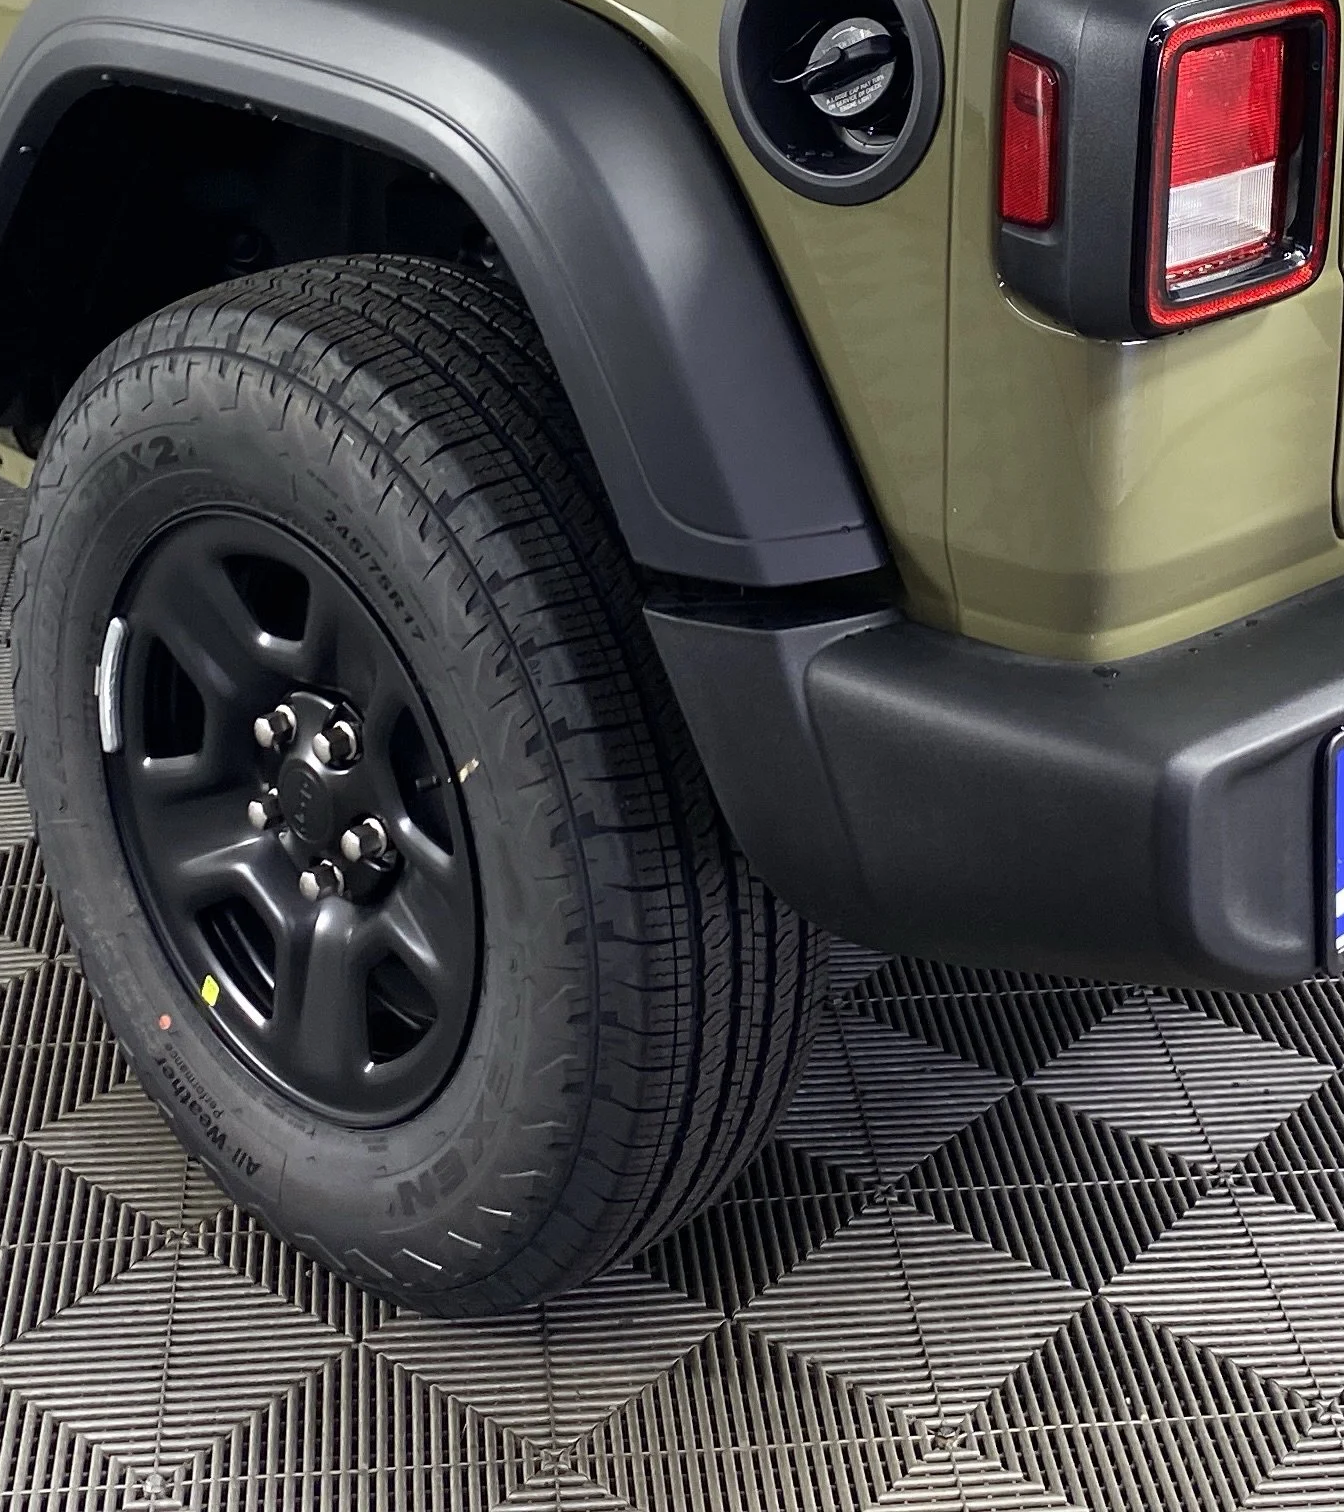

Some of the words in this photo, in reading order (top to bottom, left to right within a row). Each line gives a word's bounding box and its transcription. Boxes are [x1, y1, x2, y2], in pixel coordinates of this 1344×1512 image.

[849, 86, 859, 96] CAP
[323, 508, 426, 643] 245/75R17
[155, 1056, 227, 1151] Weather
[231, 1147, 262, 1177] All
